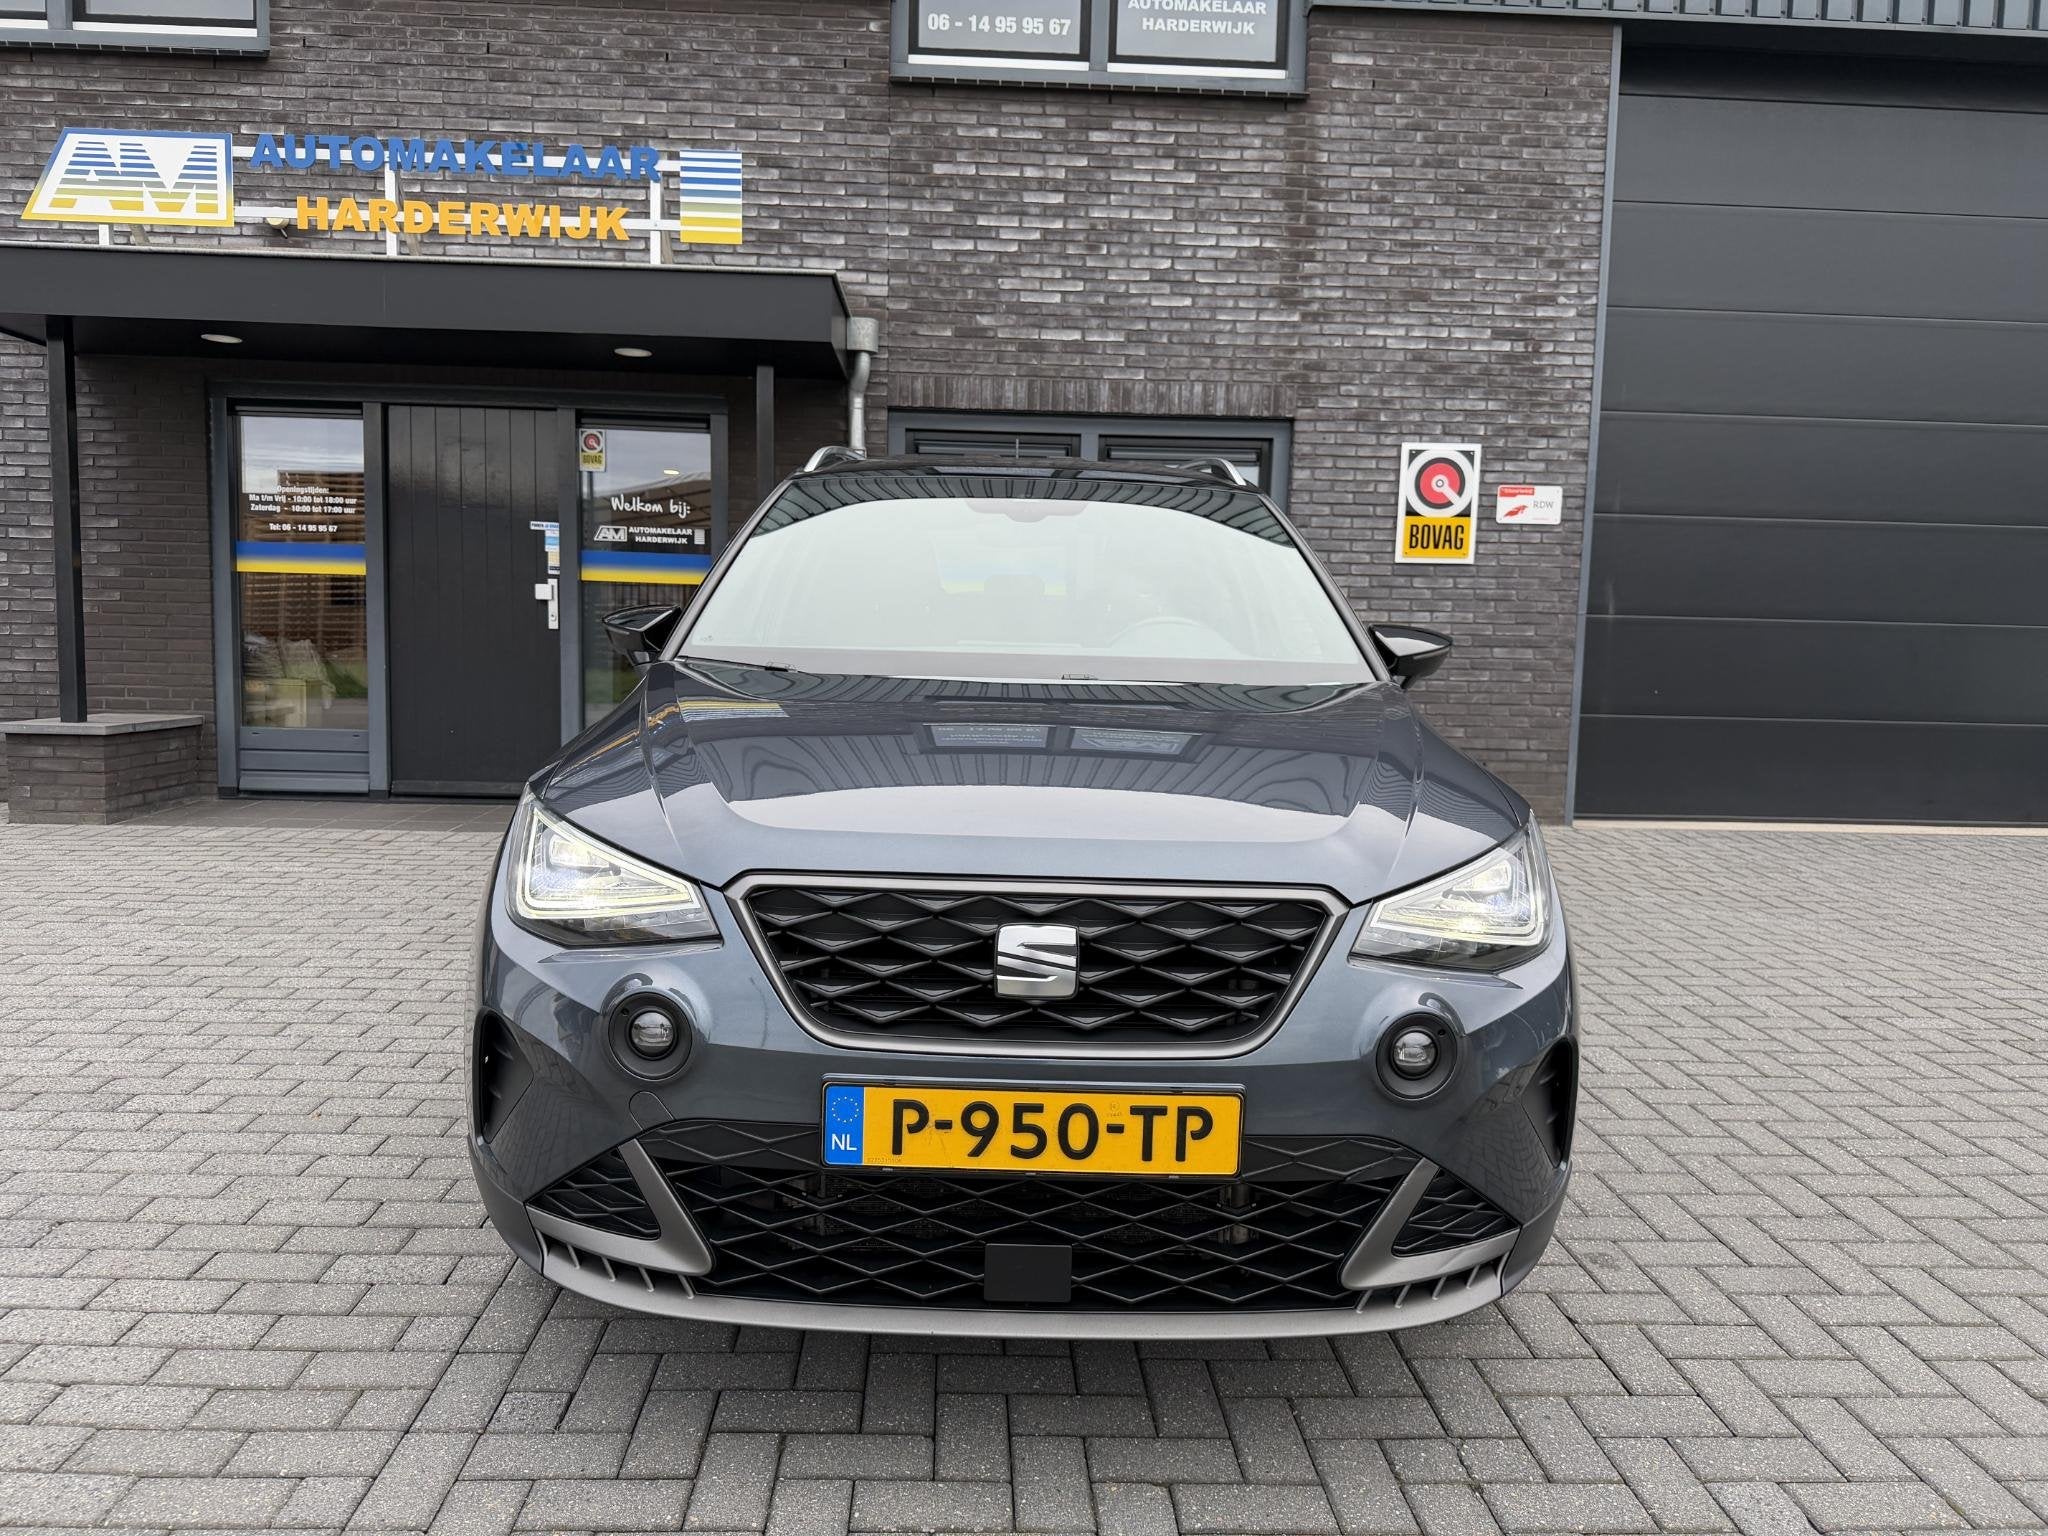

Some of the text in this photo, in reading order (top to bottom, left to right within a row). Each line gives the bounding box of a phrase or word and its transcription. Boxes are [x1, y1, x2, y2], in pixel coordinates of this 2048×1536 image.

[1127, 0, 1267, 15] AUTOMAKELAAR
[927, 13, 950, 31] 06
[968, 14, 990, 32] 14
[995, 15, 1017, 33] 95
[1022, 17, 1044, 34] 95
[1048, 18, 1071, 36] 67
[1142, 17, 1256, 34] HARDERWIJK
[249, 133, 662, 182] AUTOMAKELAAR
[47, 139, 219, 215] AM
[296, 195, 630, 241] HARDERWIJK
[582, 454, 602, 465] BOVAG
[250, 504, 281, 513] Zaterdag
[611, 493, 691, 518] Welkom bij:
[1533, 500, 1554, 509] RDW
[628, 526, 692, 535] AUTOMAKELAAR
[1409, 524, 1465, 550] BOVAG
[635, 536, 688, 544] HARDERWIJK
[891, 1098, 1214, 1162] P-950-TP
[831, 1133, 857, 1151] NL
